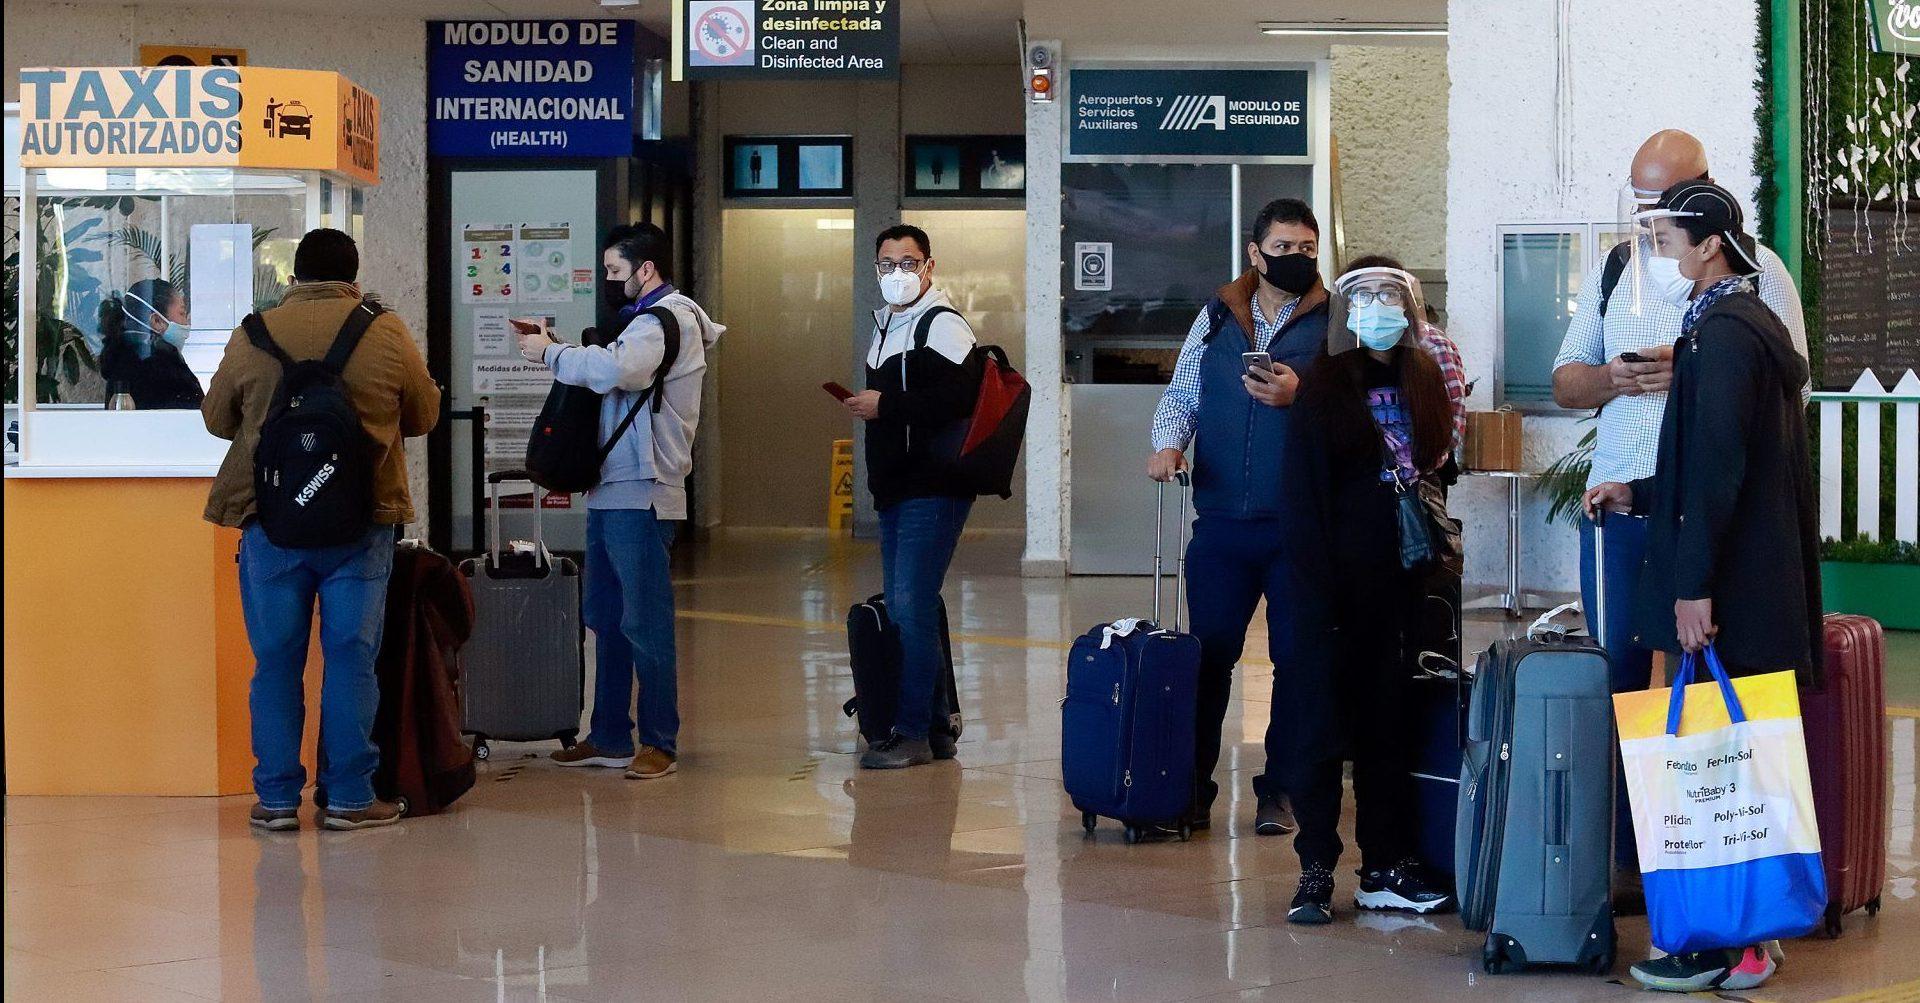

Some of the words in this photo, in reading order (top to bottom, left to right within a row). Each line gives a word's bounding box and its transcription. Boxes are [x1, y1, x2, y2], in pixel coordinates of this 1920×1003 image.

[761, 0, 808, 11] Zona
[814, 0, 872, 13] limpia
[875, 0, 886, 13] y
[762, 17, 882, 31] desinfectada
[444, 23, 570, 45] MODULO
[579, 22, 618, 45] DE
[761, 36, 805, 50] Clean
[809, 36, 838, 50] and
[761, 55, 844, 69] Disinfected
[847, 55, 884, 69] Area
[464, 60, 594, 83] SANIDAD
[20, 69, 243, 119] TAXIS
[1078, 94, 1153, 106] Aeropuertos
[1156, 97, 1164, 107] y
[435, 97, 625, 120] INTERNACIONAL
[1078, 107, 1135, 118] Servicios
[1229, 101, 1279, 112] MODULO
[1284, 101, 1300, 112] DE
[1078, 118, 1138, 130] Auxiliares
[1229, 115, 1300, 125] SEGURIDAD
[20, 120, 243, 156] AUTORIZADOS
[490, 131, 568, 149] (HEALTH)
[471, 248, 481, 260] 1
[500, 244, 511, 257] 2
[467, 265, 478, 278] 3
[501, 262, 511, 274] 4
[472, 284, 483, 296] 5
[501, 283, 511, 296] 6
[1707, 749, 1753, 768] Fer-In-Sol
[1686, 786, 1726, 799] NutriBaby
[1729, 782, 1736, 793] 3
[1694, 795, 1721, 803] PREMIUM
